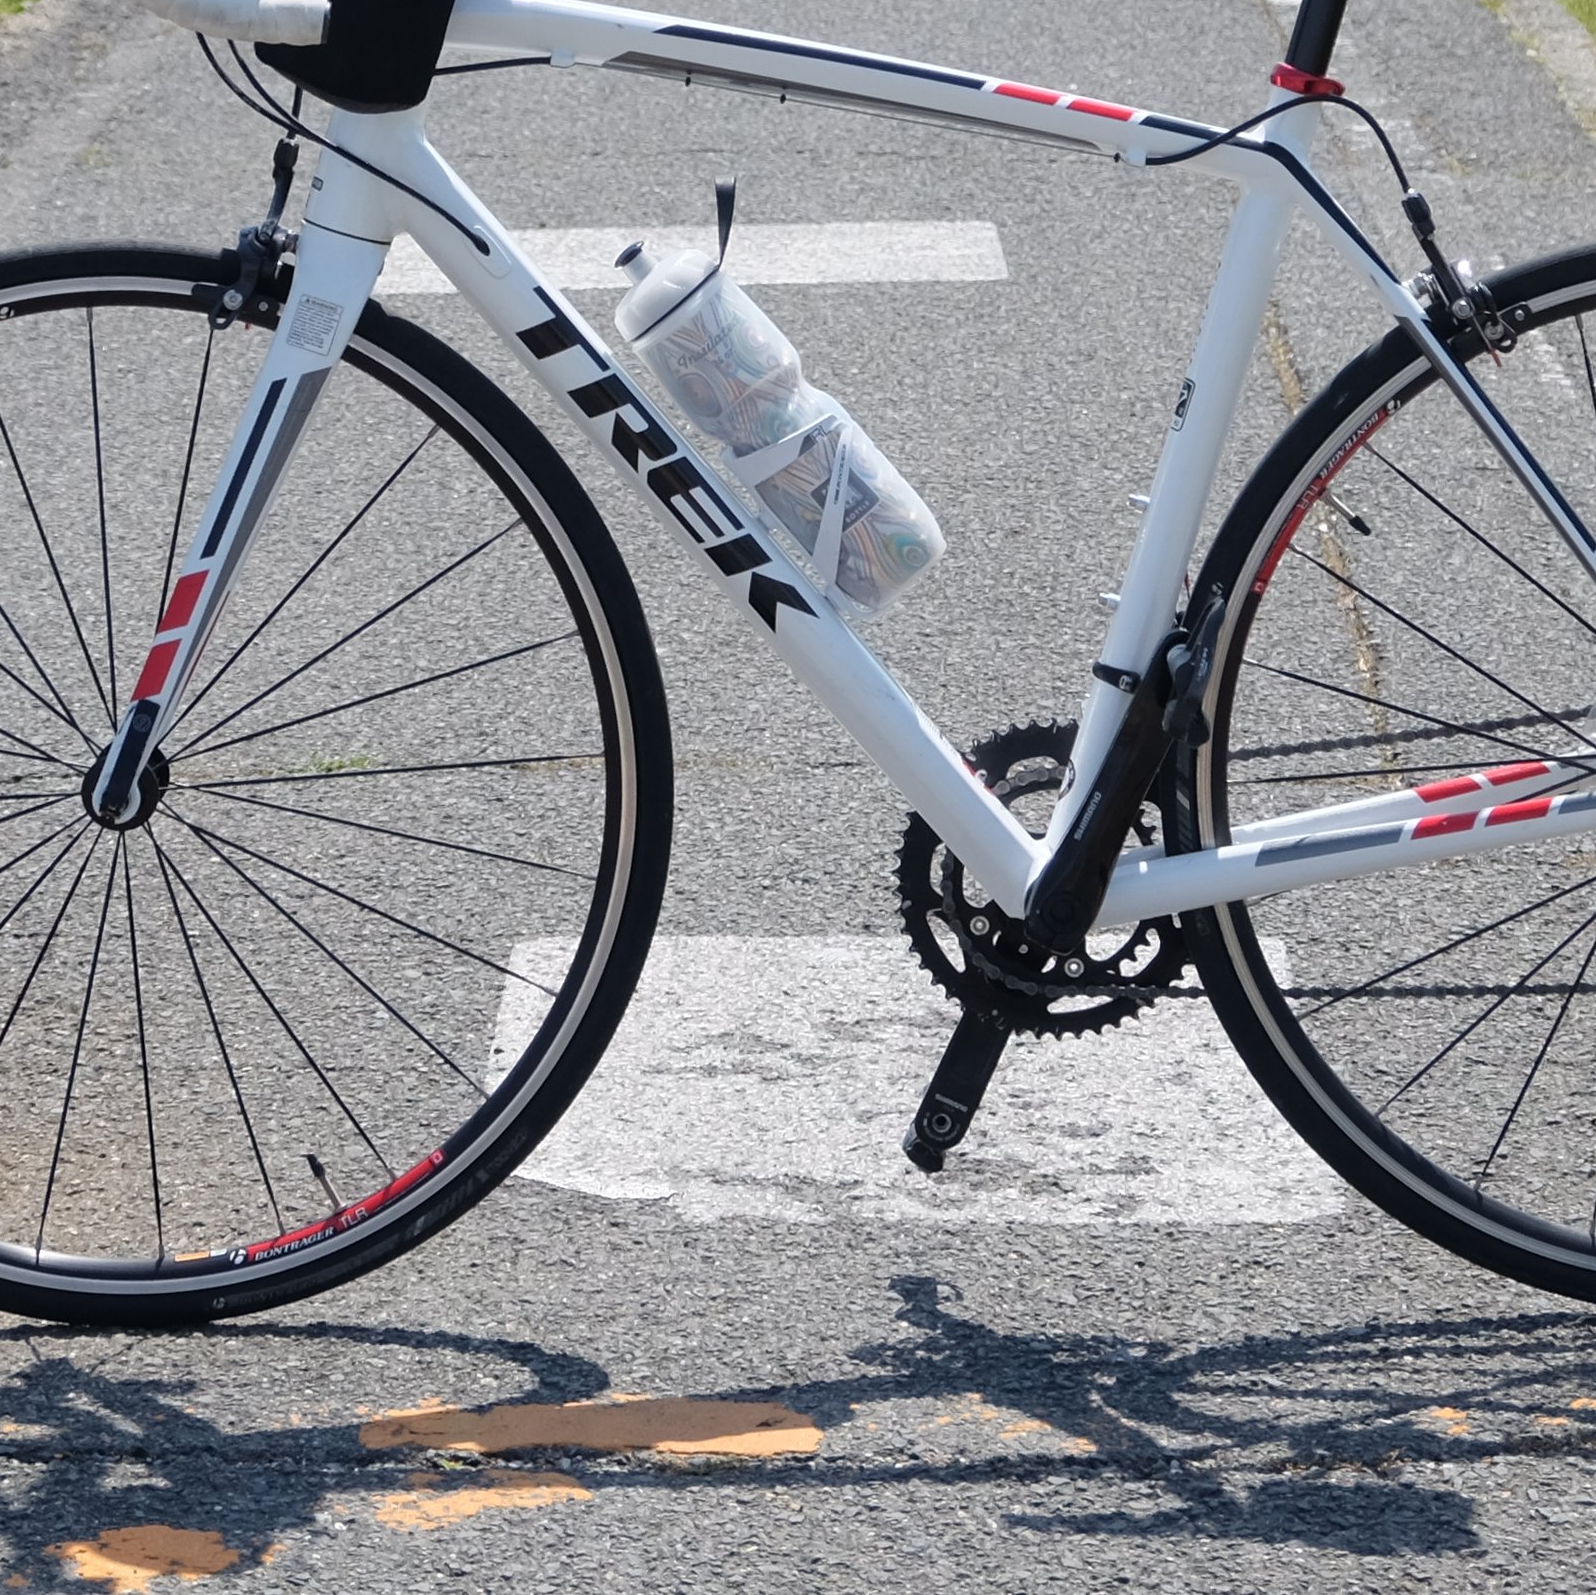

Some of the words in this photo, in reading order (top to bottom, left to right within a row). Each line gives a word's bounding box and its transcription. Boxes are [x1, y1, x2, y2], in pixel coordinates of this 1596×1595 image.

[515, 286, 820, 633] TREK
[1319, 413, 1382, 480] BONTRAGER
[254, 1226, 335, 1262] BONTRAGER
[340, 1207, 368, 1230] TLR
